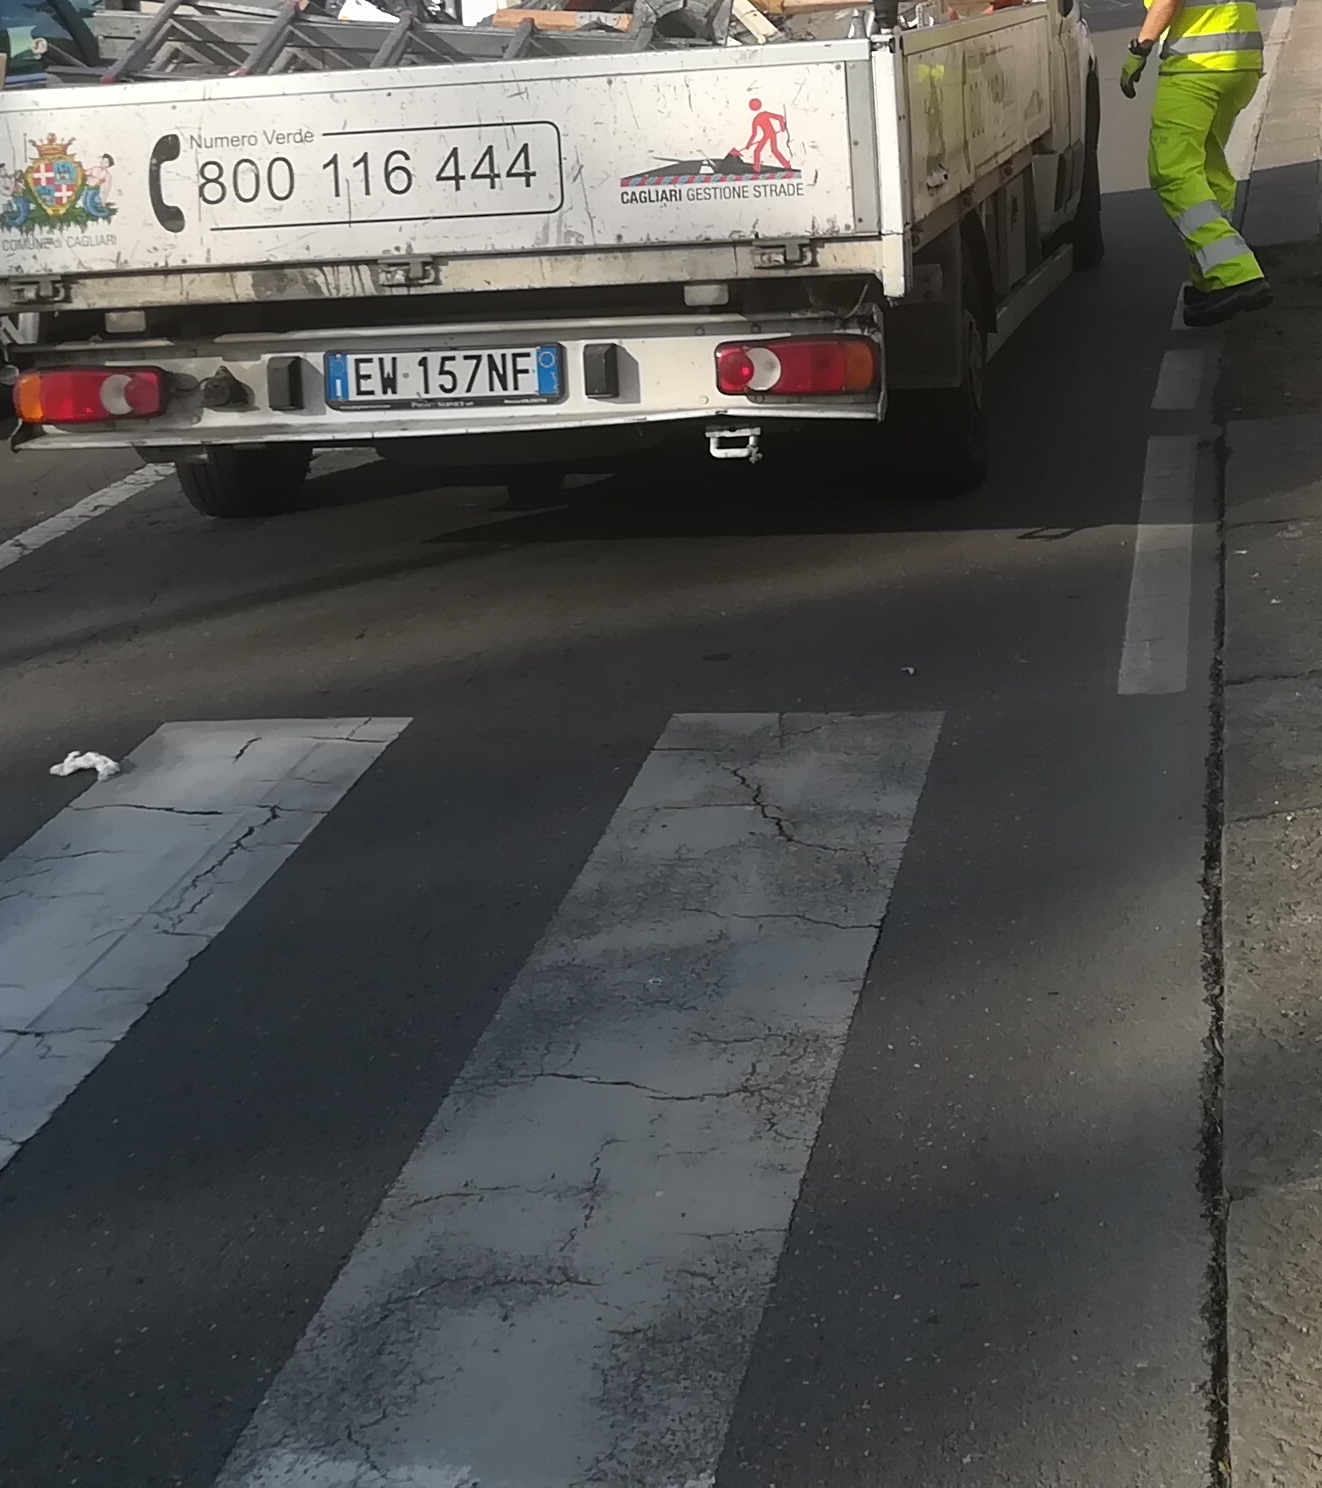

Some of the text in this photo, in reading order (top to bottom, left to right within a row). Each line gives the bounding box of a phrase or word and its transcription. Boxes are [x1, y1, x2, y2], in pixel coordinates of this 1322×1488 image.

[189, 129, 314, 149] Numero Verde
[198, 142, 537, 206] 800 116 444
[620, 182, 804, 205] CAGLIARI GESTIONE STRADE
[66, 233, 118, 248] CAGLIARI
[354, 356, 399, 396] EW
[417, 352, 532, 395] 157NF
